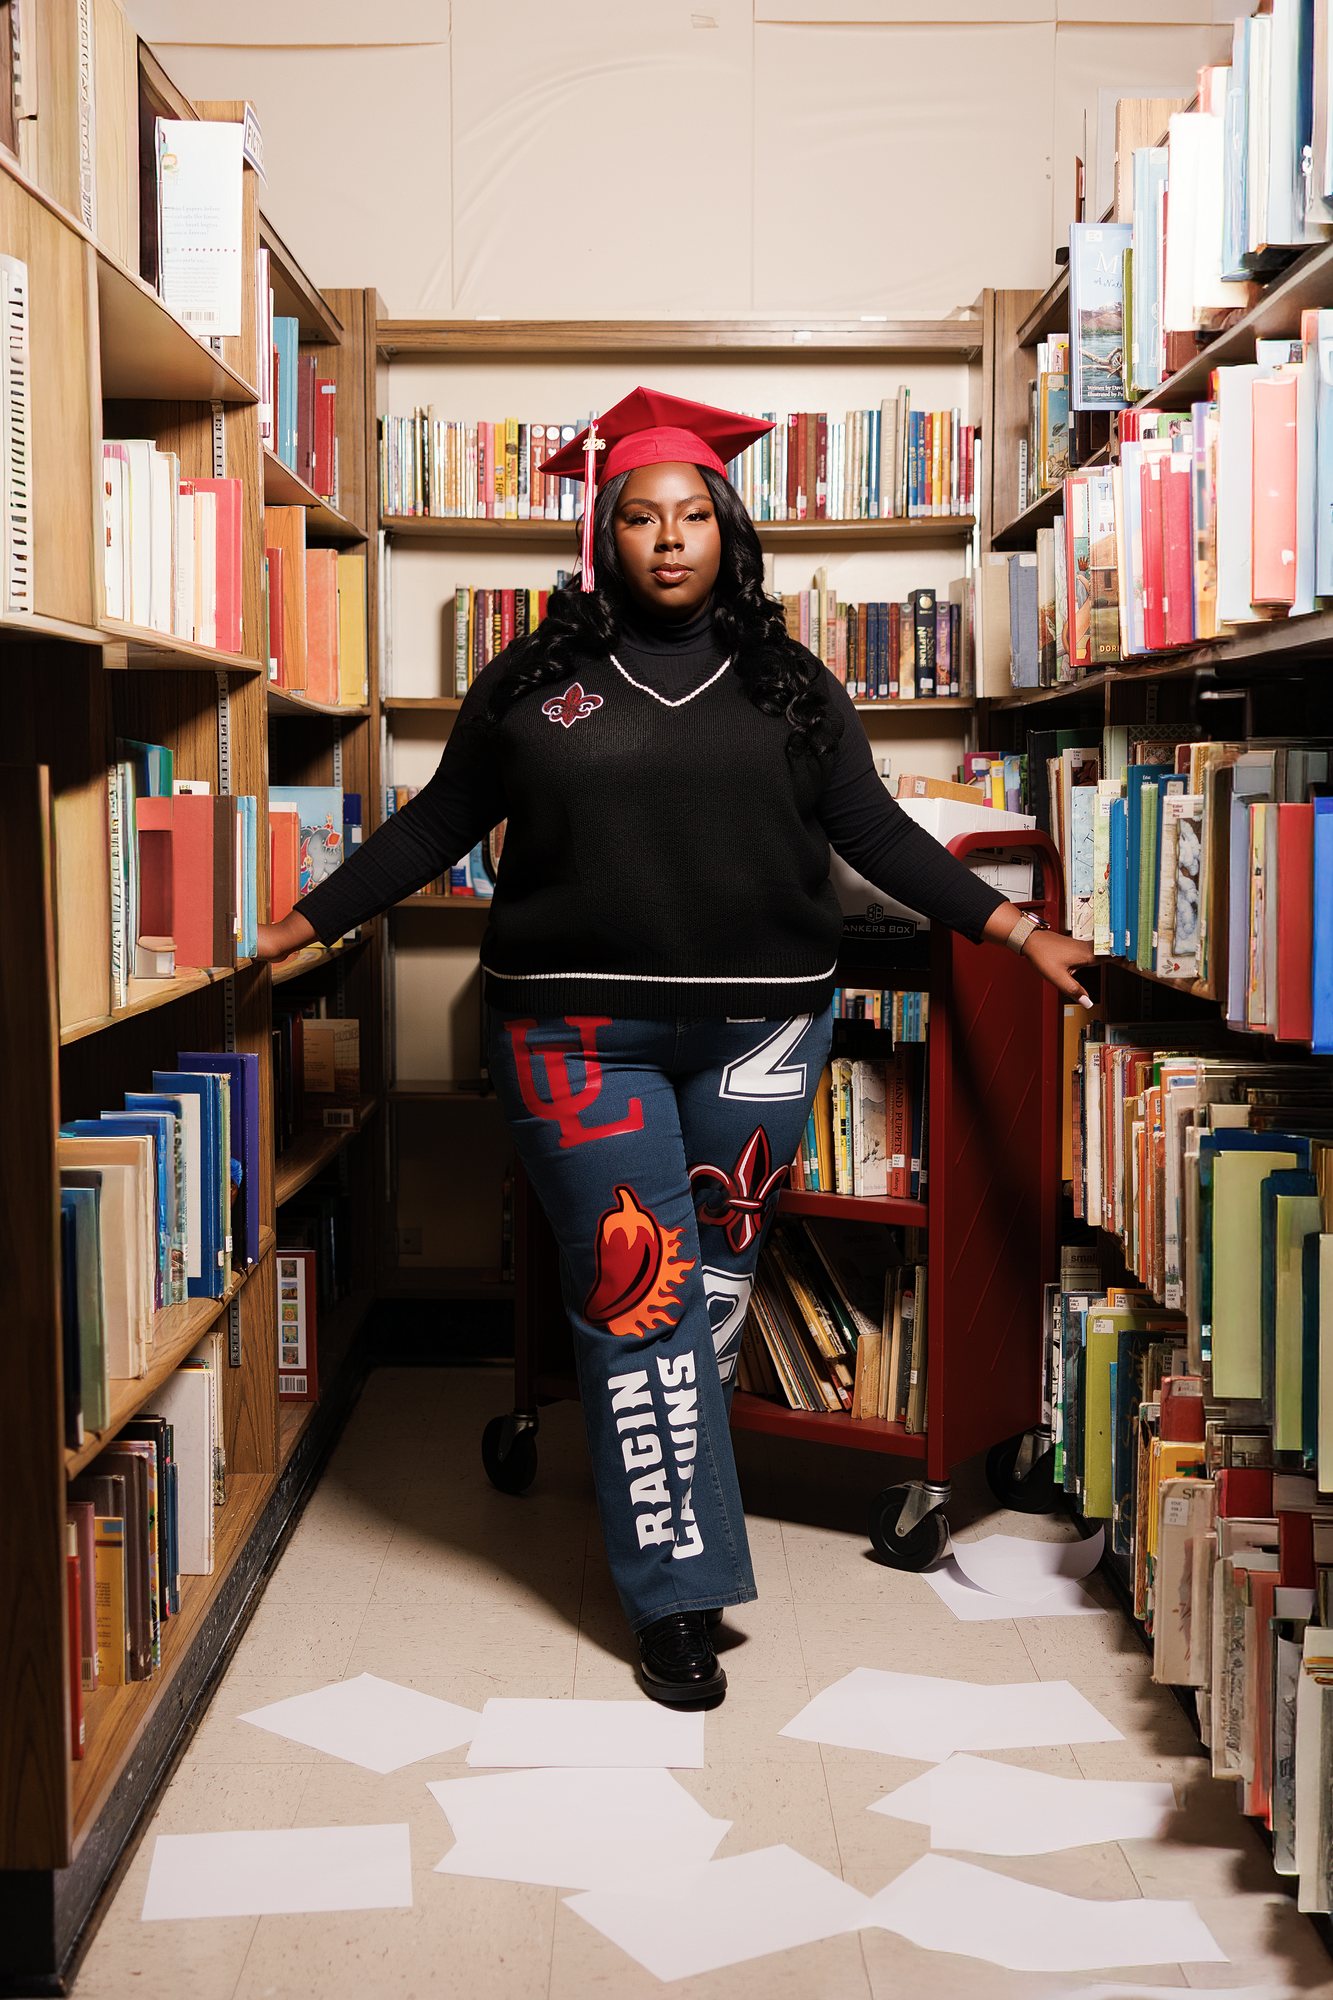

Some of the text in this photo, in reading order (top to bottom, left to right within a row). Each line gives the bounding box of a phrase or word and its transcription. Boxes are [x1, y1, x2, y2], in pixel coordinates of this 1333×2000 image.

[581, 438, 606, 451] 2026
[456, 611, 466, 679] BAMBOO PEOPLE
[916, 626, 927, 668] NEPTUNE
[926, 638, 936, 659] SON
[843, 924, 911, 934] ANKERS BOX
[894, 1077, 904, 1109] HAND
[893, 1112, 903, 1154] PUPPETS
[607, 1368, 677, 1550] RAGIN
